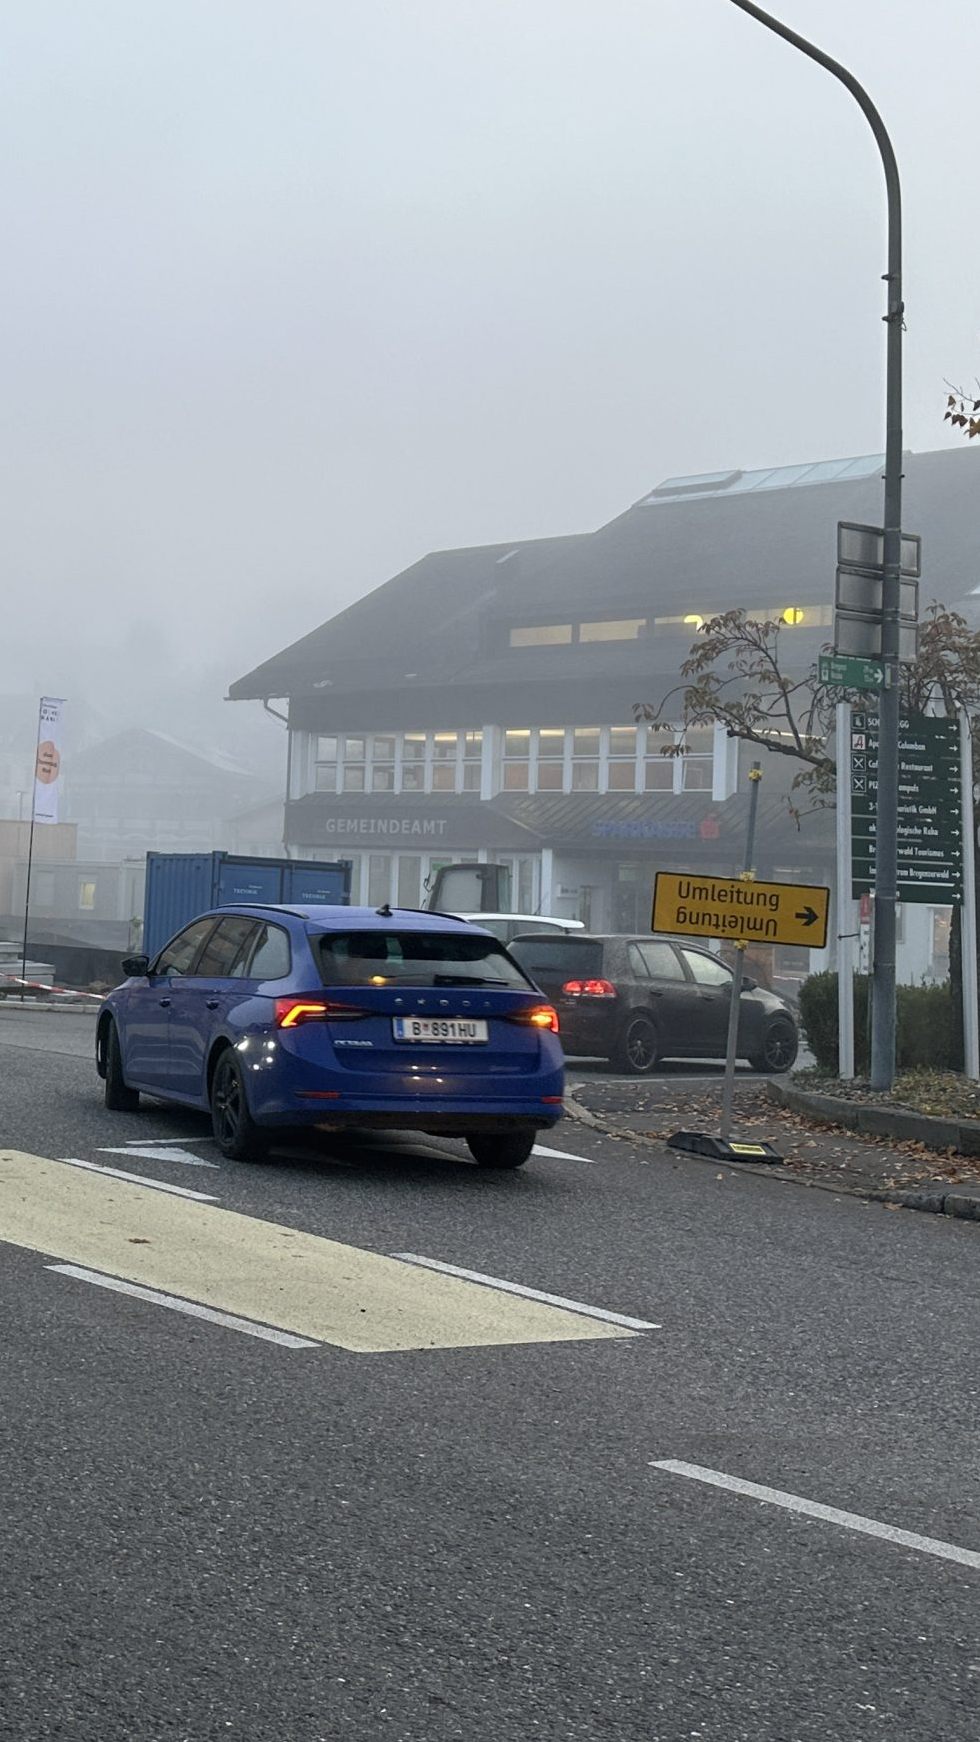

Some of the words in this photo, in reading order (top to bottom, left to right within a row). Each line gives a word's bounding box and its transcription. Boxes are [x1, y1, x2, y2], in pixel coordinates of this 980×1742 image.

[901, 762, 933, 772] Restaurant
[918, 805, 937, 815] GmbH
[326, 818, 447, 835] GEMEINDEAMT
[678, 880, 780, 912] Umleitung
[676, 906, 778, 937] Umleitung
[413, 1021, 421, 1037] B
